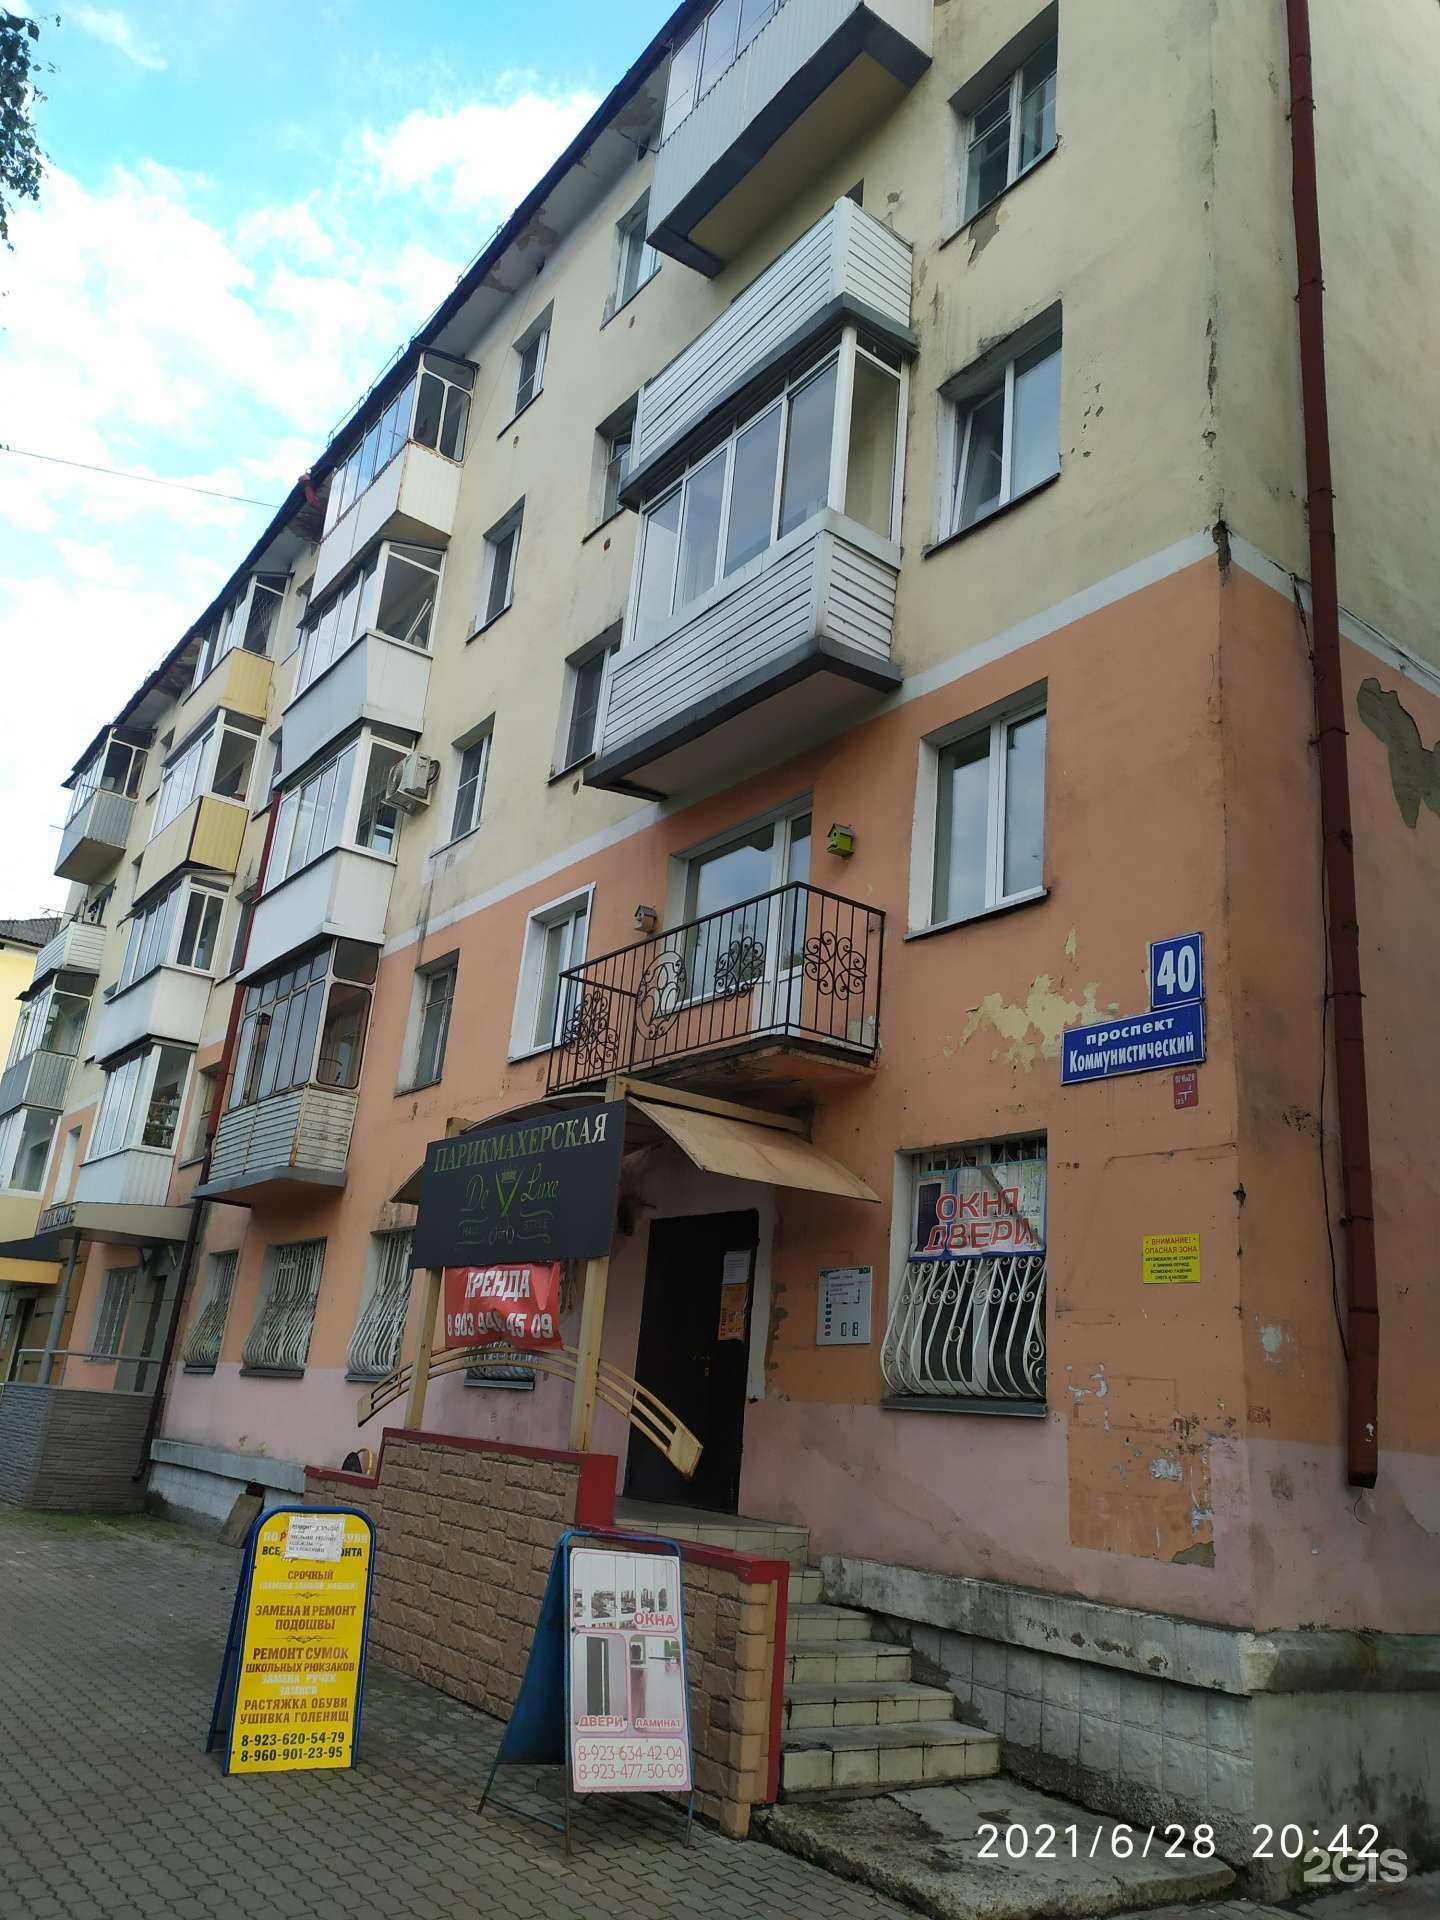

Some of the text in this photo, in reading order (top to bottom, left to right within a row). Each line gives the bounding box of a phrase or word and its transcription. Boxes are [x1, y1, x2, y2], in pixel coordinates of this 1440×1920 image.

[1157, 945, 1196, 995] 40
[1086, 1017, 1175, 1046] проспект
[1069, 1031, 1194, 1073] Коммунистический
[433, 1113, 608, 1173] ПАРИКМАХЕРСКАЯ
[924, 1217, 1037, 1252] ДВЕРИ
[261, 1545, 280, 1556] ВСЕ
[287, 1569, 334, 1580] СРОЧНЫЙ
[255, 1605, 357, 1616] ЗАМЕНА И РЕМОНТ
[274, 1619, 336, 1631] ПОДОШВЫ
[633, 1612, 676, 1627] ОКНА
[253, 1647, 349, 1660] РЕМОНТ СУМОК
[245, 1662, 355, 1673] ШКОЛЬНЫХ РЮКЗАКОВ
[244, 1697, 348, 1710] РАСТЯЖКА ОБУВИ
[240, 1711, 349, 1724] УШИВКА ГОЛЕНИЩ
[579, 1716, 624, 1728] ДВЕРИ
[241, 1731, 345, 1747] 8-923-620-54-79
[240, 1746, 343, 1762] 8-960-901-23-95
[578, 1745, 682, 1761] 8-923-634-42-04
[579, 1763, 684, 1780] 8-923-477-50-09
